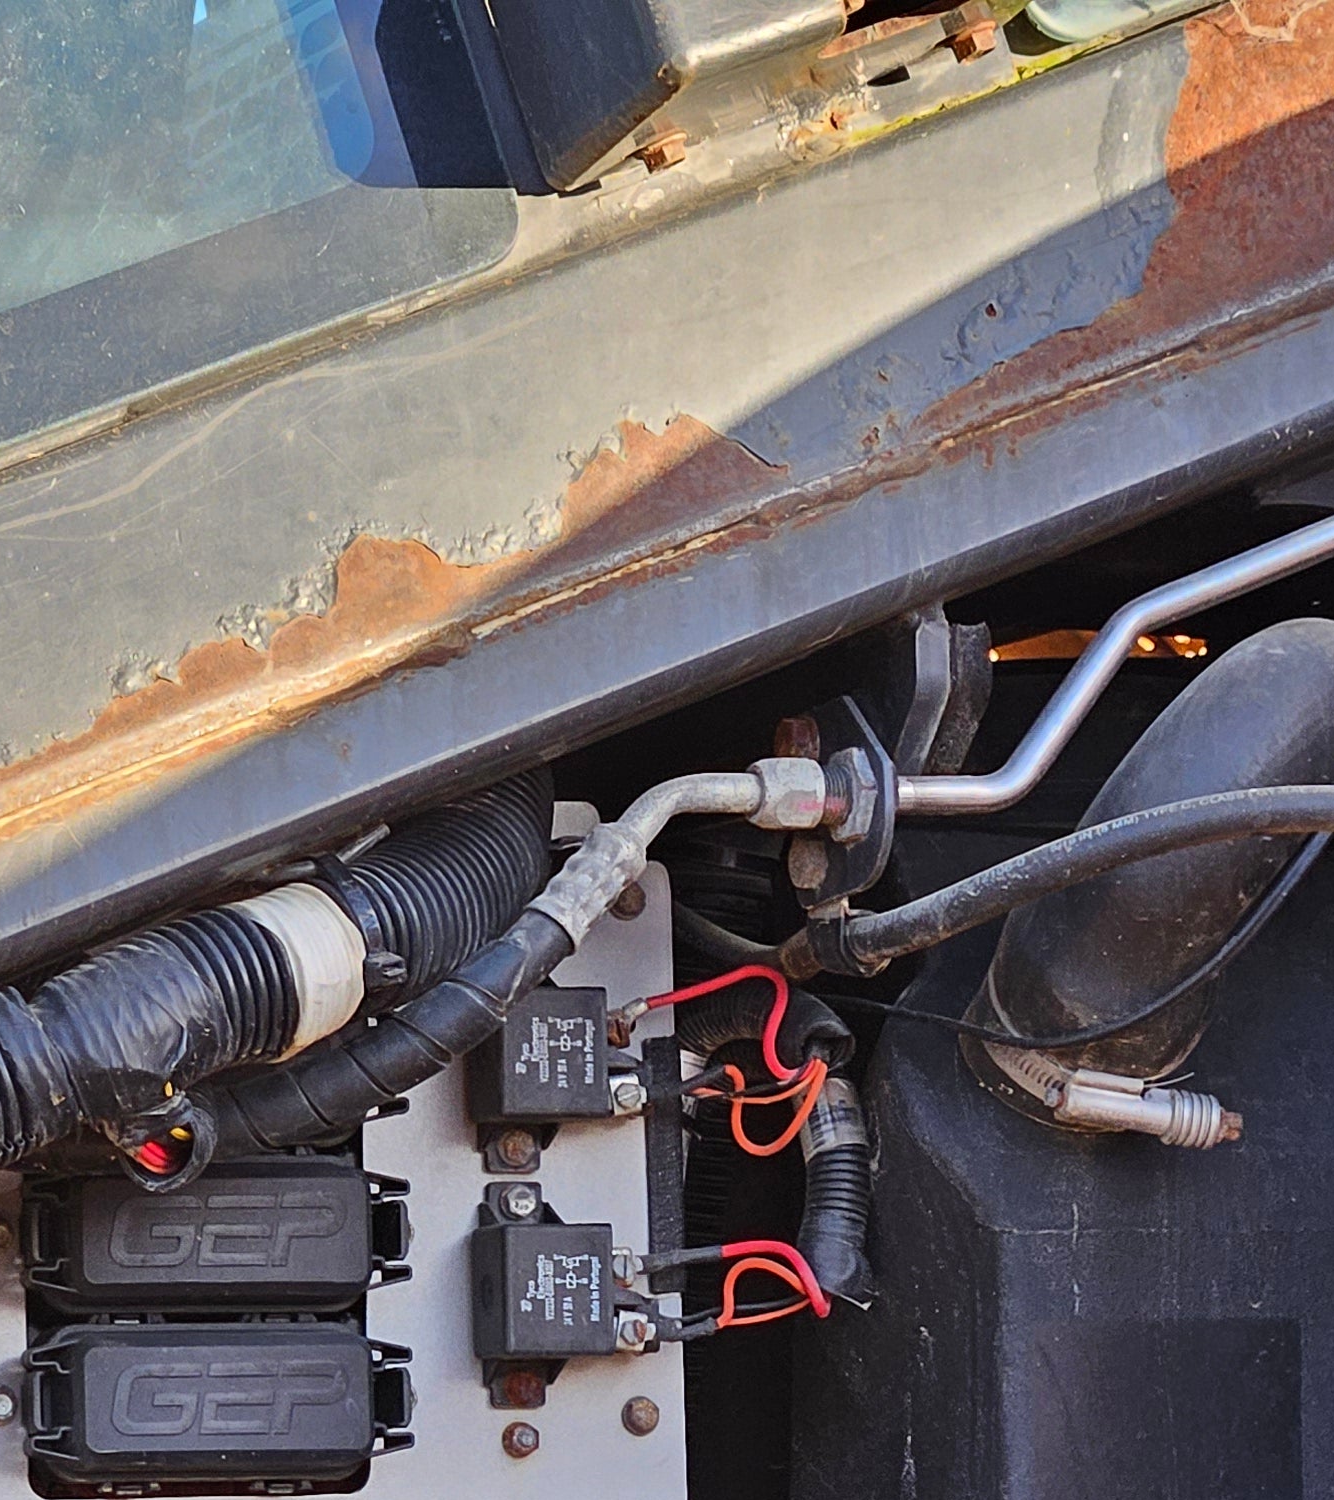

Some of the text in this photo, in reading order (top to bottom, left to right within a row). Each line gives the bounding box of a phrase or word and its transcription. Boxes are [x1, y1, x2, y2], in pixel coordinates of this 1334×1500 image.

[584, 1019, 595, 1053] Portugal
[109, 1194, 348, 1267] GEP
[590, 1256, 601, 1290] Portugal
[110, 1359, 350, 1437] GEP
